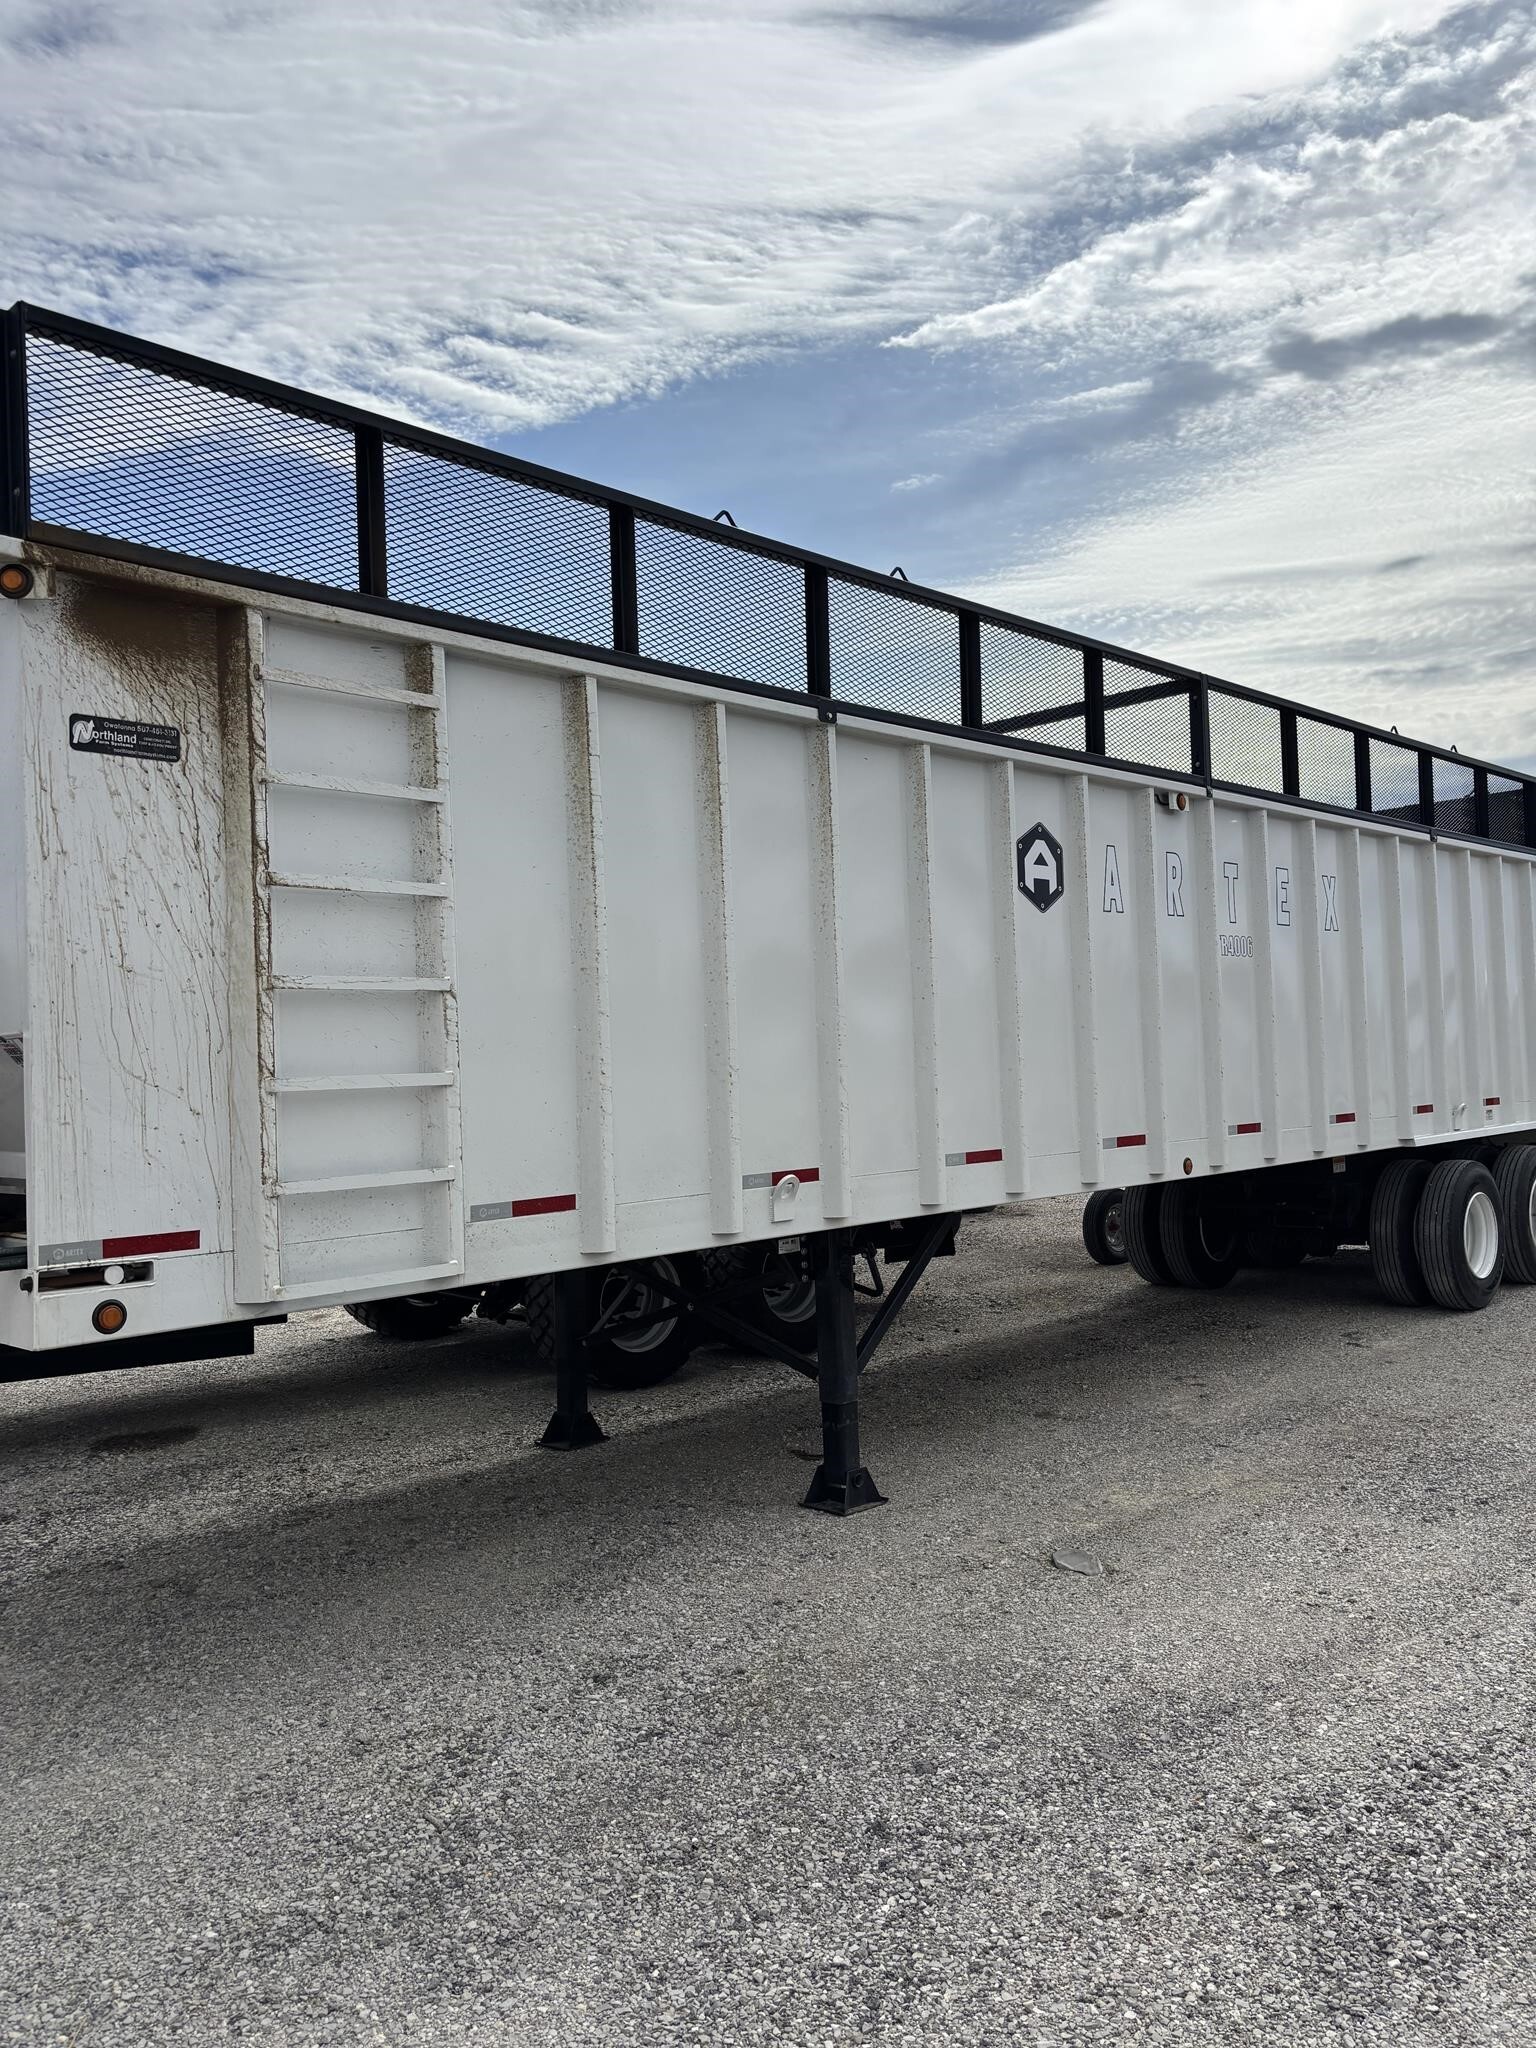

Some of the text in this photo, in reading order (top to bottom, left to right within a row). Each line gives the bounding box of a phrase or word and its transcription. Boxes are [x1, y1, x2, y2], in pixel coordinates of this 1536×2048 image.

[72, 720, 137, 744] Northland
[103, 721, 136, 731] Owatonna
[111, 740, 134, 748] Systems
[1024, 839, 1057, 895] A
[1219, 934, 1254, 957] R4006
